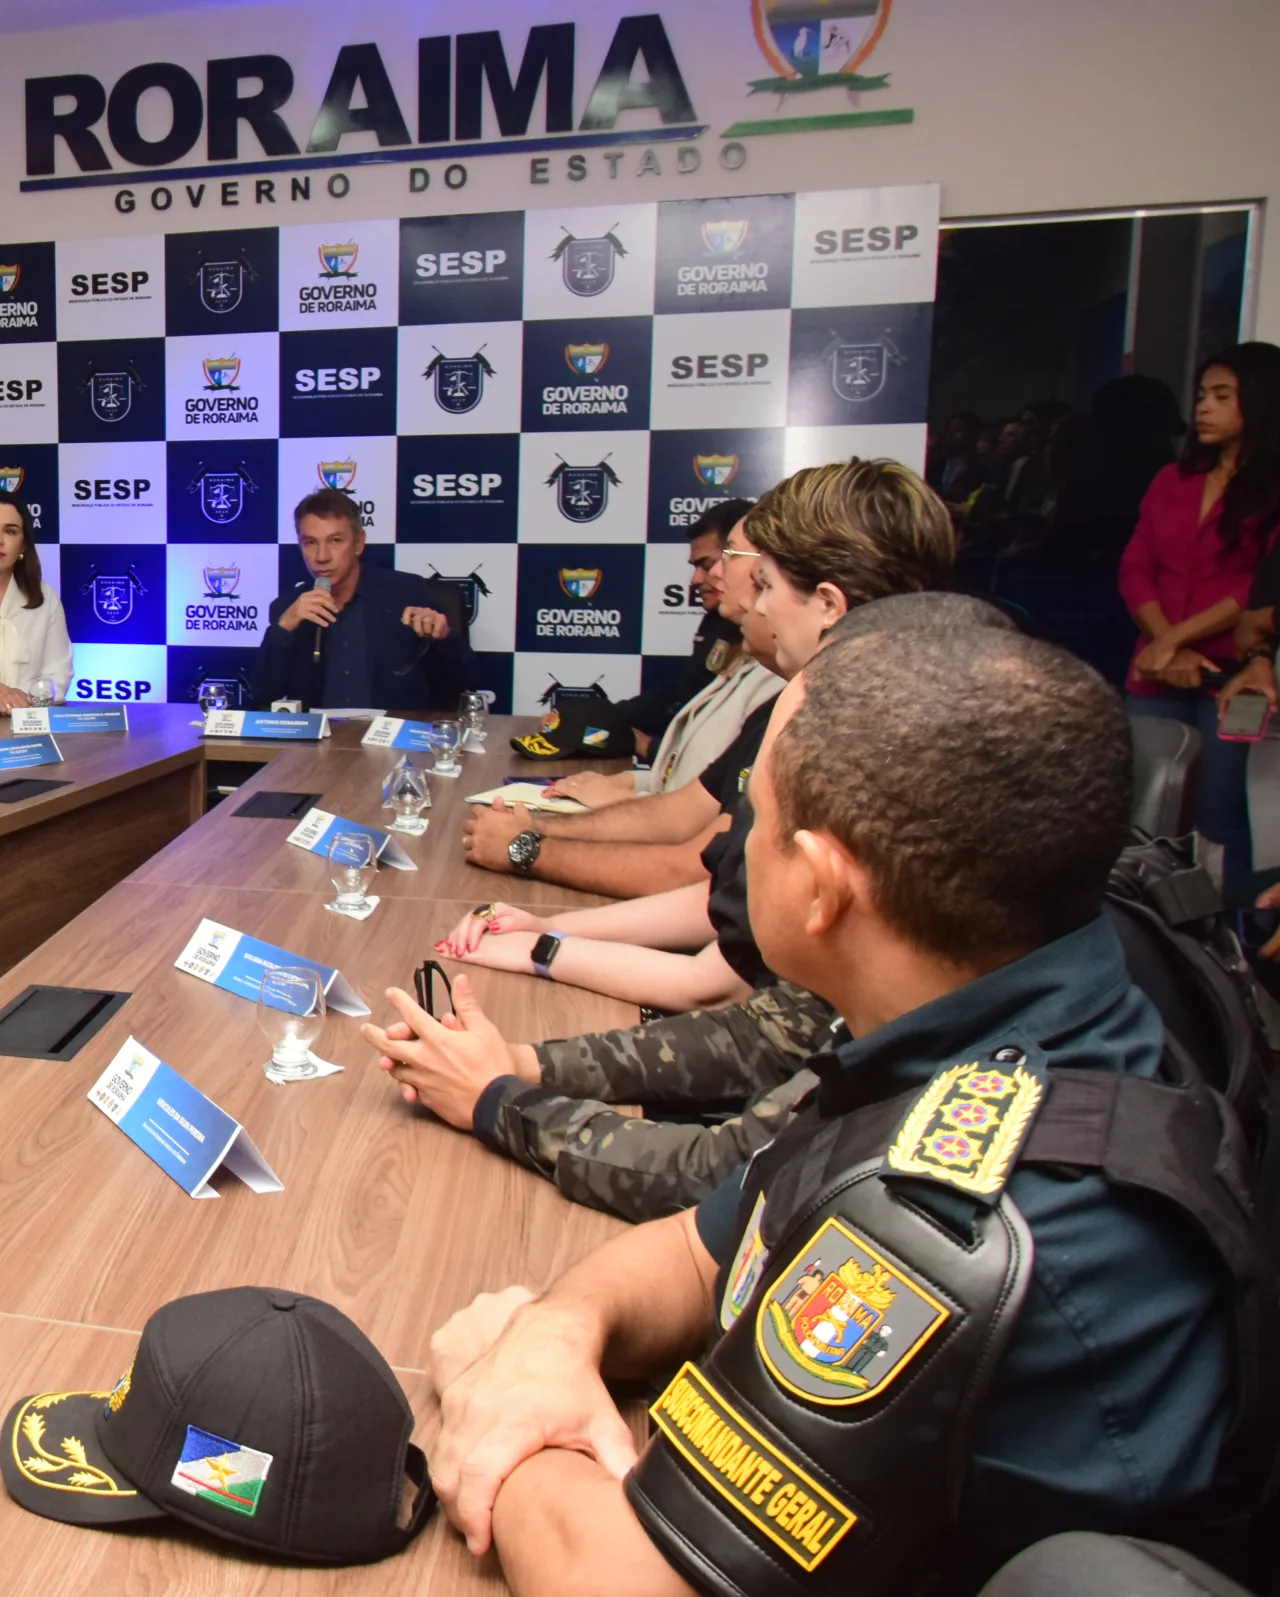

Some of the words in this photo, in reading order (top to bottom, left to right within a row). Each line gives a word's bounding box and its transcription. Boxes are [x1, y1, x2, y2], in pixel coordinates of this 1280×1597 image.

[25, 13, 697, 176] RORAIMA
[114, 172, 350, 213] GOVERNO
[409, 164, 468, 193] DO
[530, 142, 748, 184] ESTADO
[815, 225, 918, 254] SESP
[416, 250, 506, 279] SESP
[678, 262, 768, 281] GOVERNO
[72, 272, 148, 295] SESP
[300, 284, 376, 301] GOVERNO
[677, 283, 698, 296] DE
[699, 279, 768, 296] RORAIMA
[299, 302, 315, 313] DE
[318, 299, 377, 312] RORAIMA
[671, 354, 768, 379] SESP
[296, 367, 380, 391] SESP
[543, 385, 628, 402] GOVERNO
[186, 397, 258, 412] GOVERNO
[542, 403, 561, 415] DE
[562, 400, 628, 415] RORAIMA
[185, 414, 200, 424] DE
[203, 412, 258, 424] RORAIMA
[74, 479, 150, 500] SESP
[413, 474, 501, 496] SESP
[669, 514, 688, 526] DE
[663, 584, 703, 607] SE
[186, 605, 257, 619] GOVERNO
[537, 609, 620, 624] GOVERNO
[185, 620, 200, 630] DE
[203, 620, 258, 631] RORAIMA
[537, 625, 556, 637] DE
[557, 625, 620, 637] RORAIMA
[77, 679, 151, 700] SESP
[196, 947, 221, 962] GOVERNO
[822, 1281, 875, 1331] RORAIMA
[662, 1378, 783, 1506] SUBCOMANDANTE
[766, 1482, 836, 1555] GERAL
